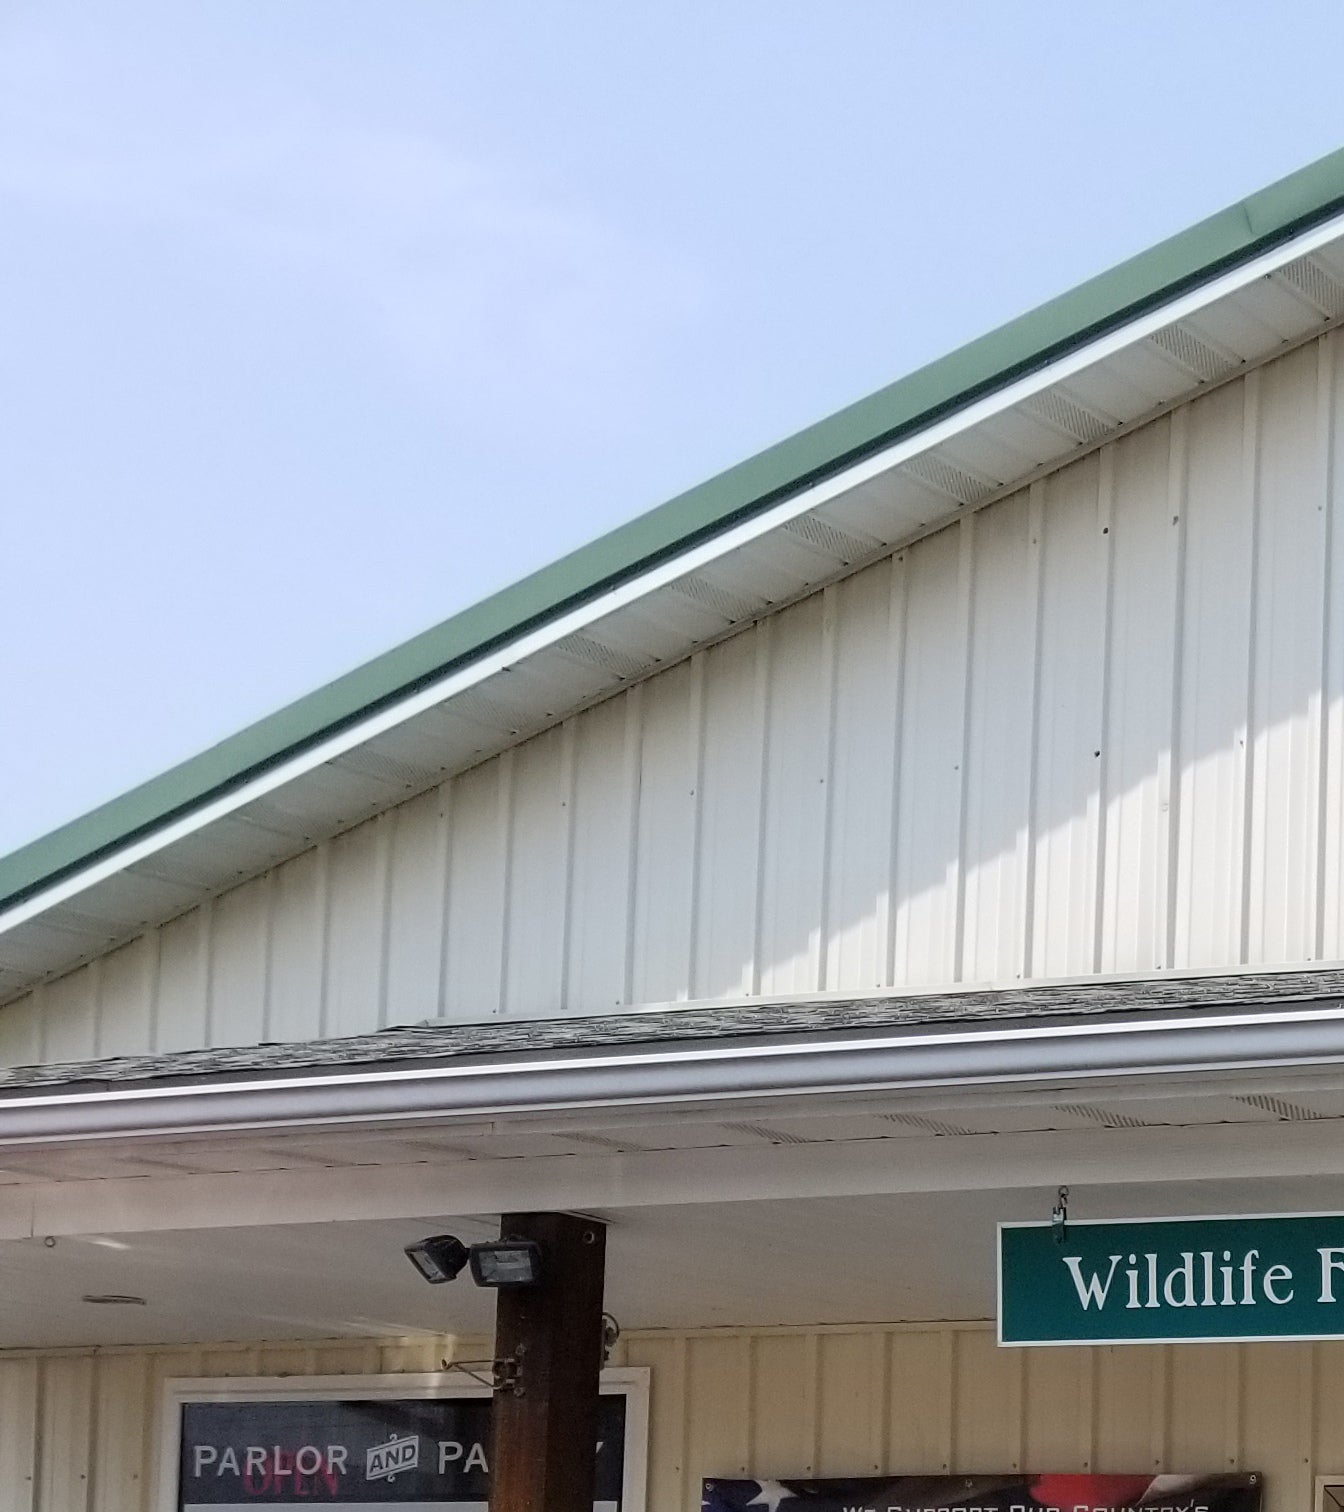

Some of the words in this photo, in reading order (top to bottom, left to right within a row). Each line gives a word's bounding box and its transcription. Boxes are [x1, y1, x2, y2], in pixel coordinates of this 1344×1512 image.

[1063, 1249, 1294, 1311] Wildlife
[193, 1444, 348, 1478] PARLOR
[369, 1444, 416, 1475] AND
